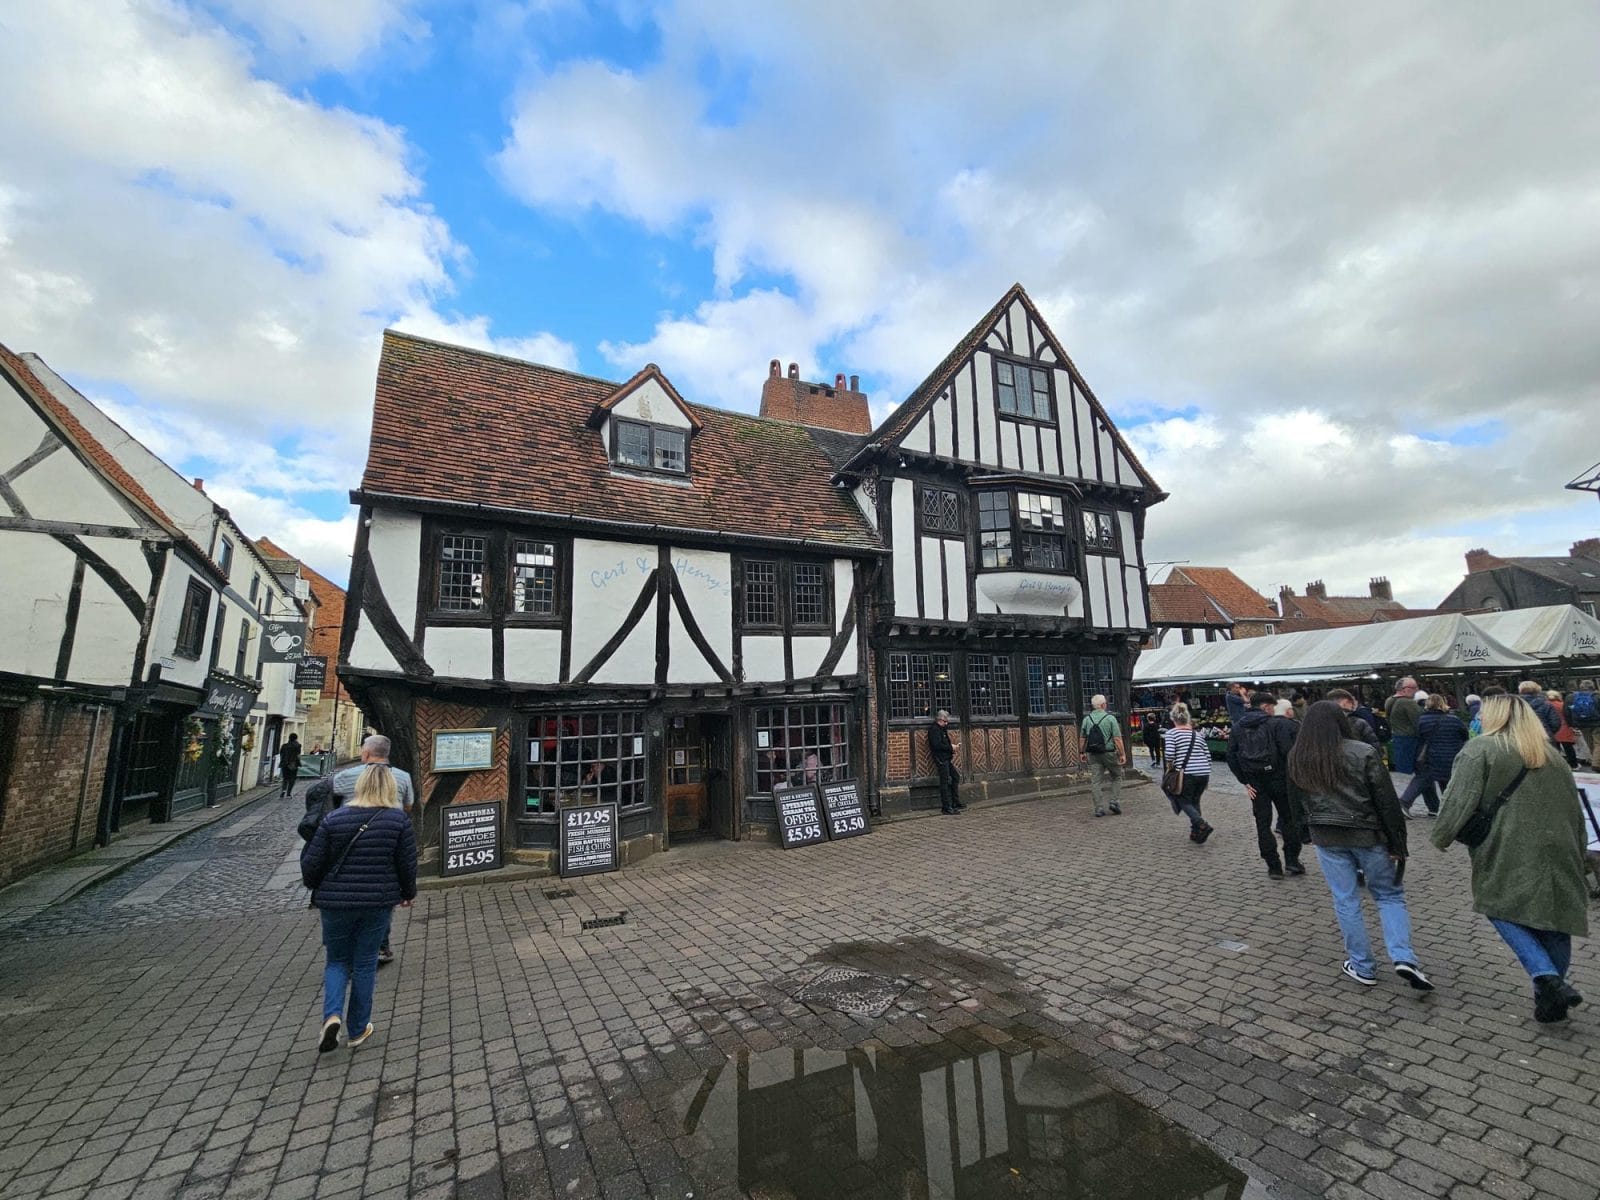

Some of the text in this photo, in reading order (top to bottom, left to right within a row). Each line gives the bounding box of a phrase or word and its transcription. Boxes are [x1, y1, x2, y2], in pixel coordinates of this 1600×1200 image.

[591, 561, 628, 588] Gert
[636, 557, 650, 573] &
[449, 808, 495, 819] TRADITIONAL
[567, 809, 610, 827] £12.95
[784, 811, 818, 826] OFFER
[449, 819, 475, 827] ROAST
[833, 816, 865, 834] £3.50
[448, 831, 496, 844] POTATOES
[787, 825, 821, 842] £5.95
[447, 848, 495, 869] £15.95
